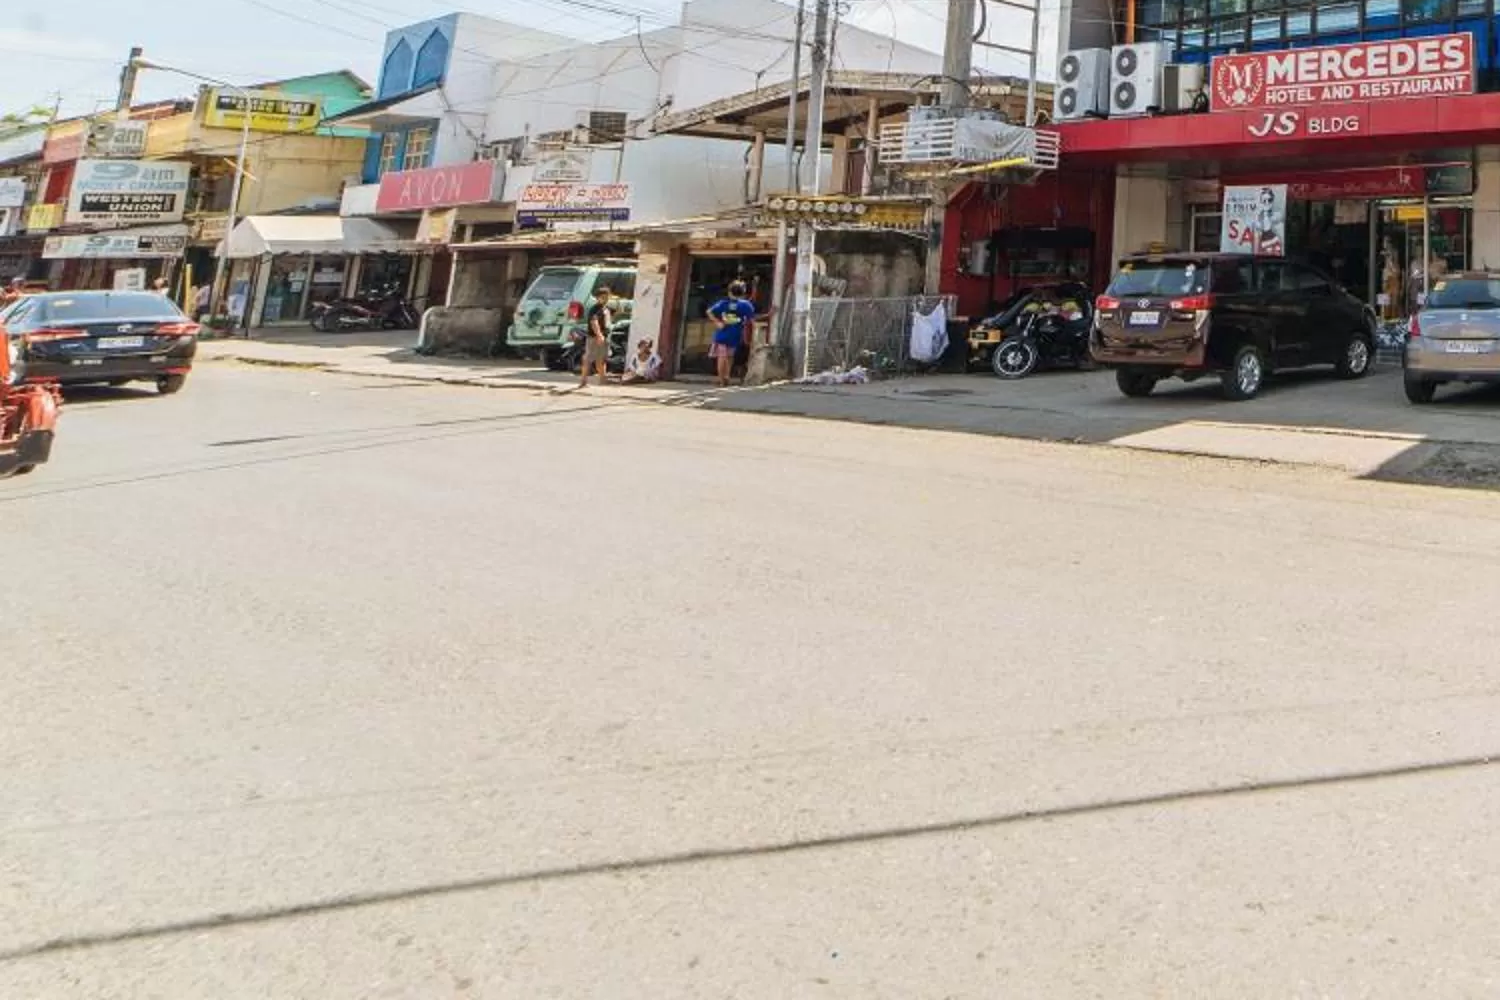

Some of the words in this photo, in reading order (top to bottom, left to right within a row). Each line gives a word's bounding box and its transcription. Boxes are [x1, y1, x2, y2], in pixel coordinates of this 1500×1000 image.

[1265, 37, 1466, 85] MERCEDES
[1265, 86, 1315, 105] HOTEL
[1321, 83, 1354, 100] AND
[1359, 75, 1467, 98] RESTAURANT
[1248, 111, 1299, 136] JS
[1308, 115, 1359, 133] BLDG
[84, 194, 164, 203] WESTERN
[400, 171, 464, 205] AVON
[108, 202, 161, 211] UNION
